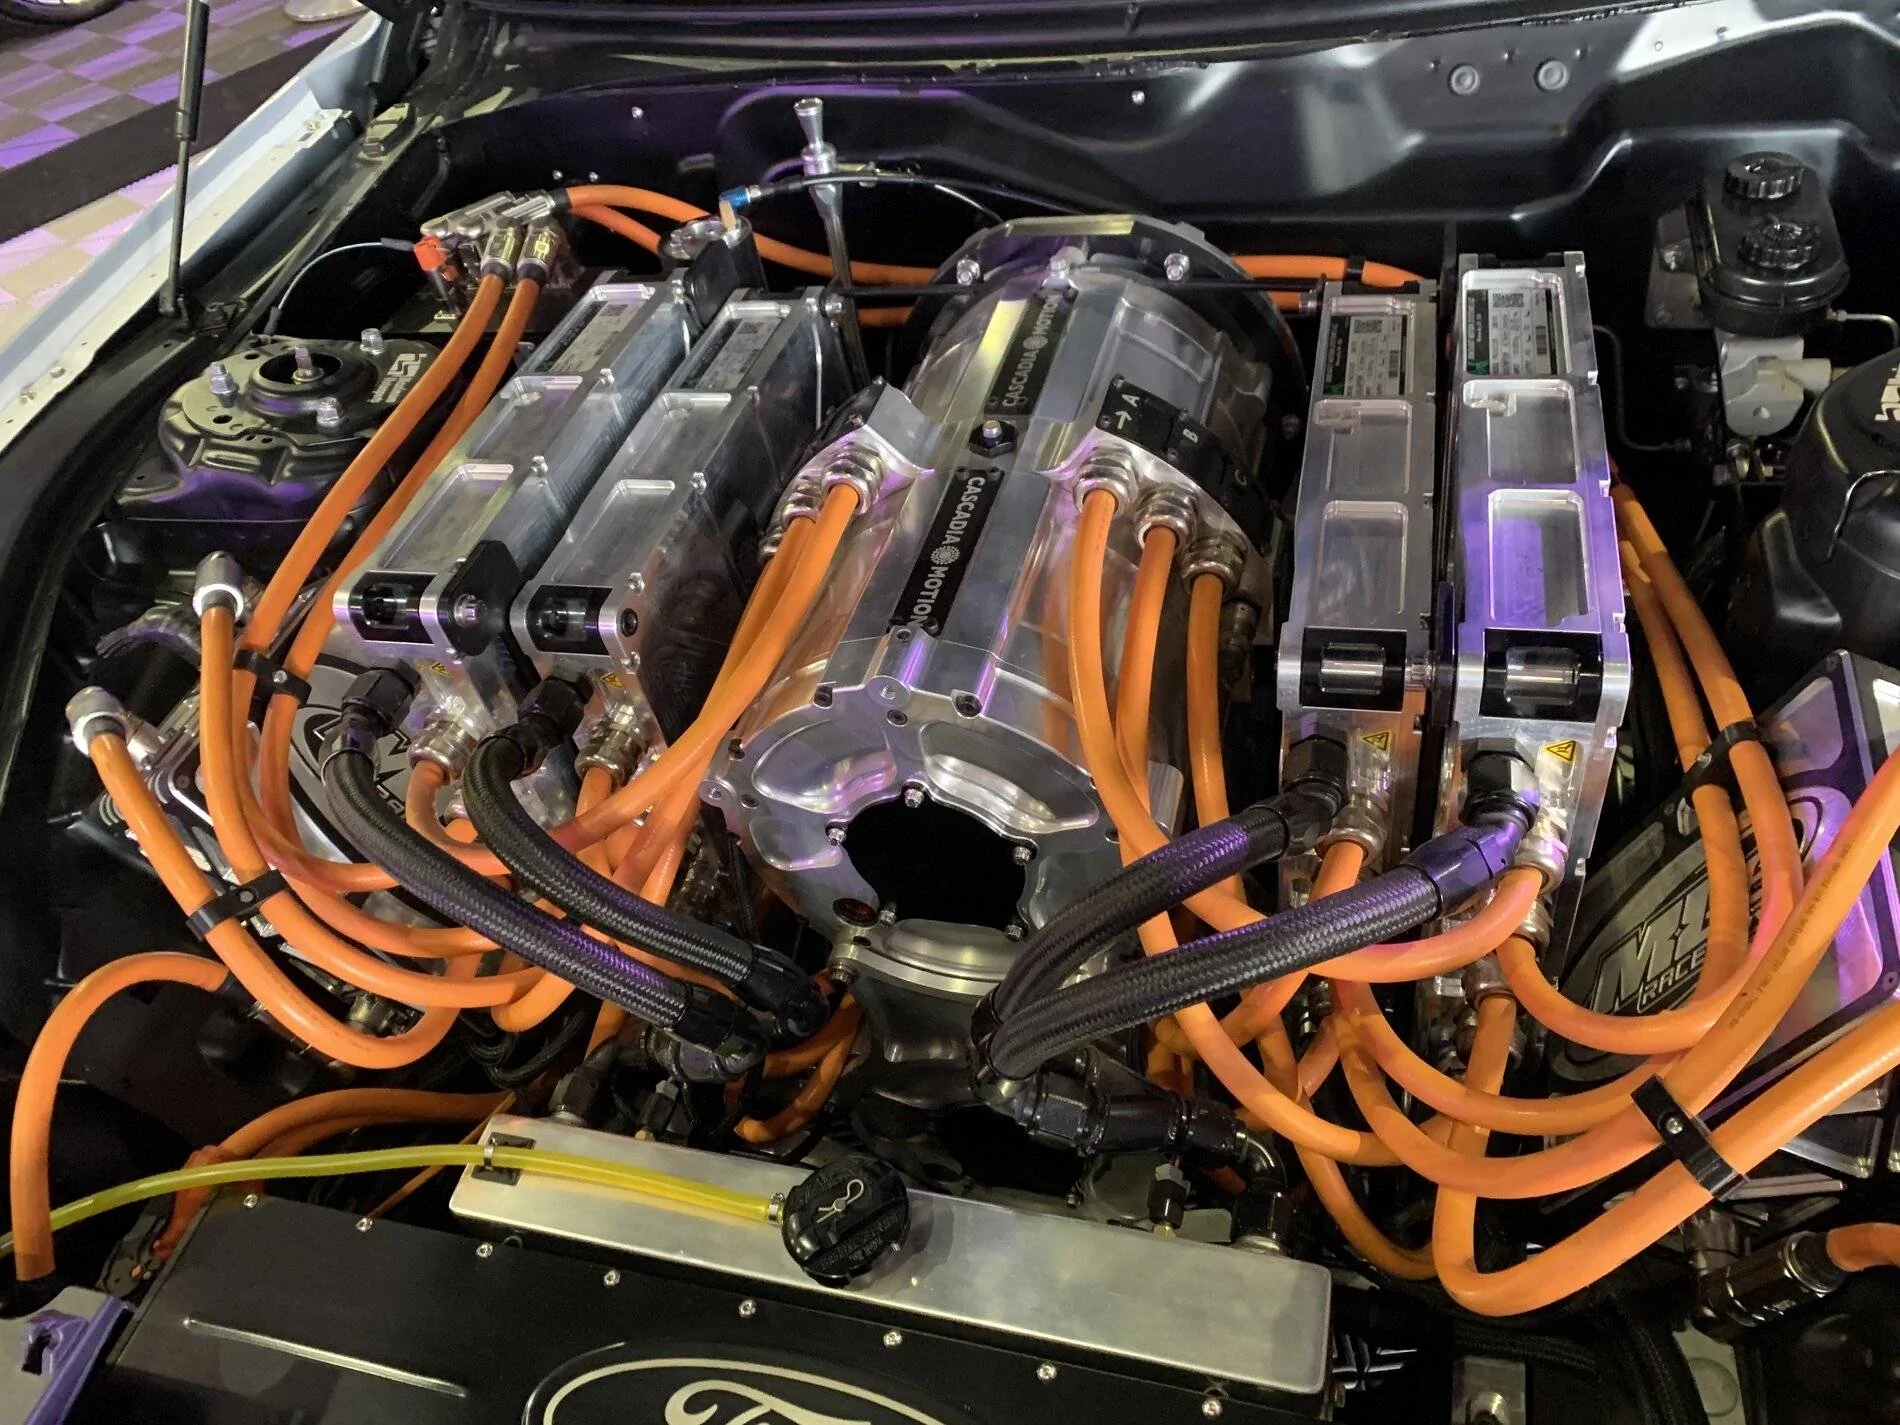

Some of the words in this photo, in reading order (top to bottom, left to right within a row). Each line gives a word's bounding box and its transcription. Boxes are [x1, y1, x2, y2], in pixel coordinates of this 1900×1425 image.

[1002, 348, 1039, 407] CASCADIA
[1032, 294, 1061, 335] MOTION
[1121, 393, 1140, 408] A
[1182, 428, 1199, 444] B
[944, 476, 986, 545] CASCADIA
[906, 566, 949, 629] MOTION
